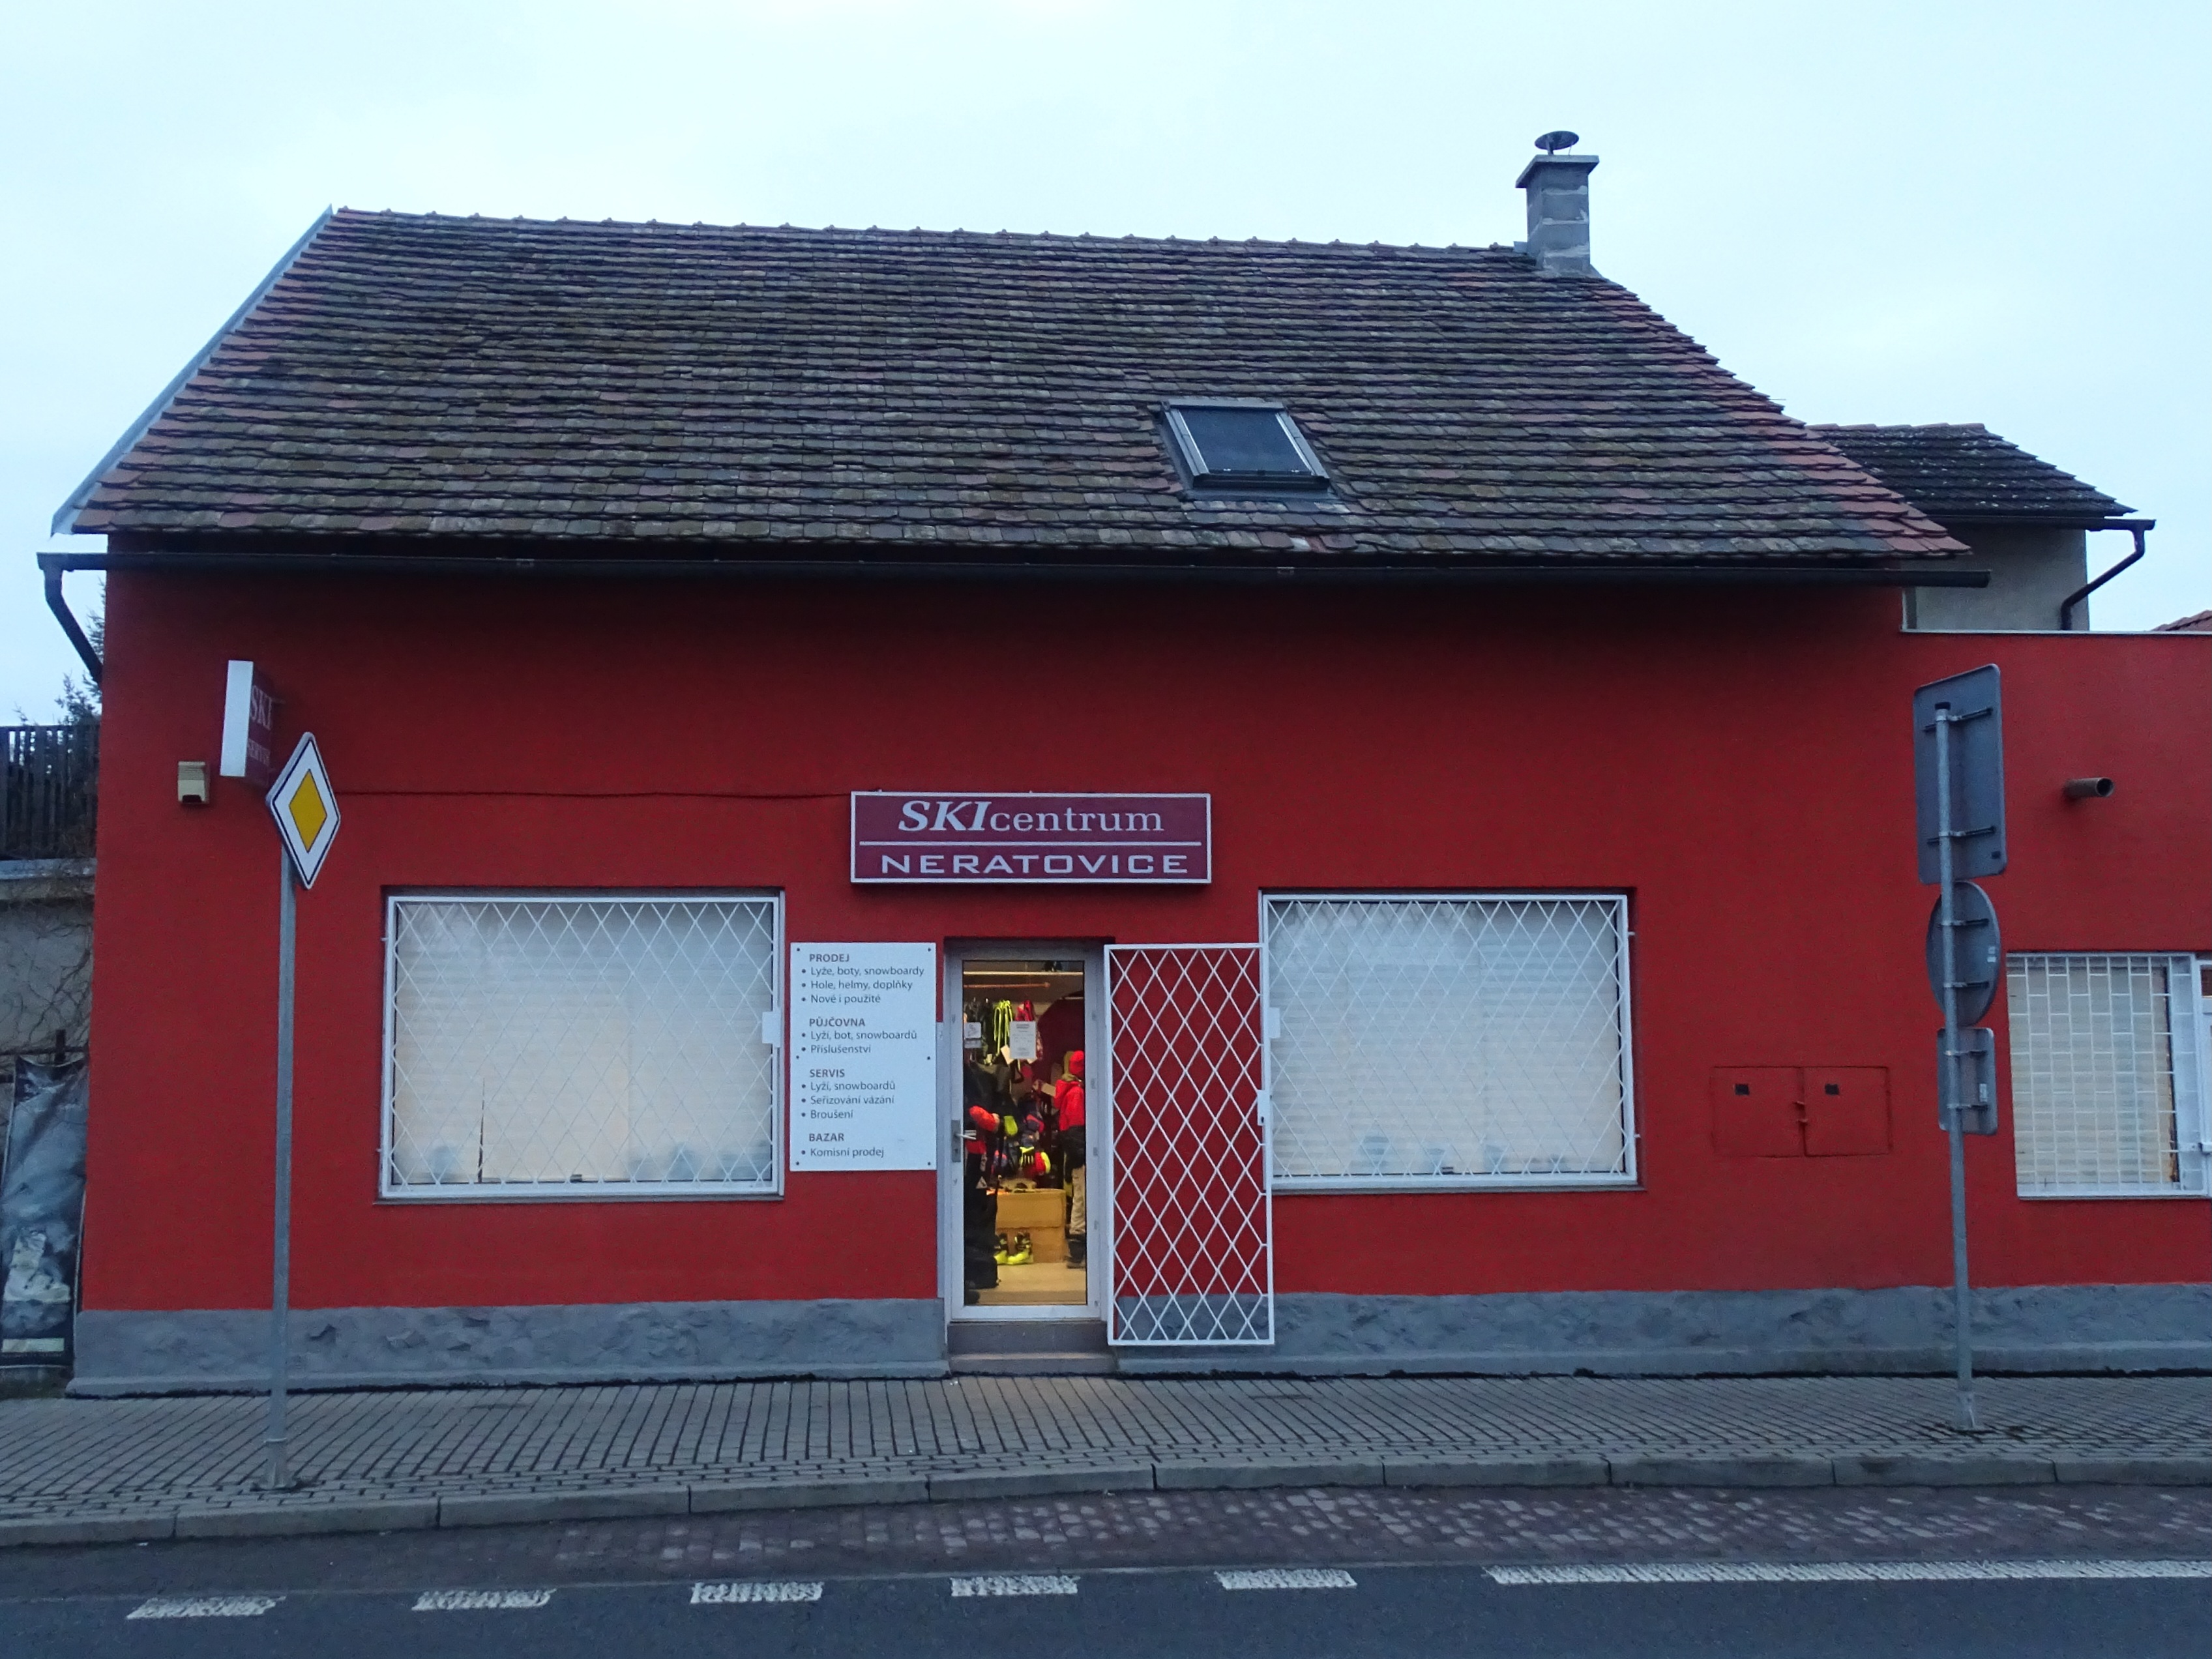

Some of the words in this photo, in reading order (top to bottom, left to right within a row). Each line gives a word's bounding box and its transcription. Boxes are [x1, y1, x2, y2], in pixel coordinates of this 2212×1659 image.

[250, 685, 273, 729] SKI
[898, 800, 1164, 832] SKIcentrum
[881, 855, 1188, 874] NERATOVICE
[809, 954, 849, 962] PRODEJ
[810, 966, 834, 977] Lyže,
[837, 966, 862, 977] boty,
[864, 966, 924, 977] snowboardy
[810, 980, 835, 990] Hole,
[838, 980, 870, 991] helmy,
[872, 980, 913, 991] doplňky
[810, 994, 836, 1003] Nové
[838, 994, 842, 1003] i
[844, 994, 881, 1005] použité
[809, 1016, 866, 1027] PŮJČOVNA
[810, 1031, 832, 1041] Lyží,
[834, 1031, 853, 1040] bot,
[856, 1030, 917, 1039] snowboardů
[810, 1044, 871, 1053] Příslušenství
[810, 1069, 846, 1078] SERVIS
[810, 1081, 832, 1093] Lyží,
[834, 1081, 895, 1090] snowboardů
[810, 1095, 861, 1104] Seřizování
[863, 1095, 894, 1104] vázání
[810, 1109, 853, 1119] Broušení
[809, 1133, 845, 1141] BAZAR
[810, 1148, 850, 1156] Komisní
[852, 1147, 884, 1158] prodej
